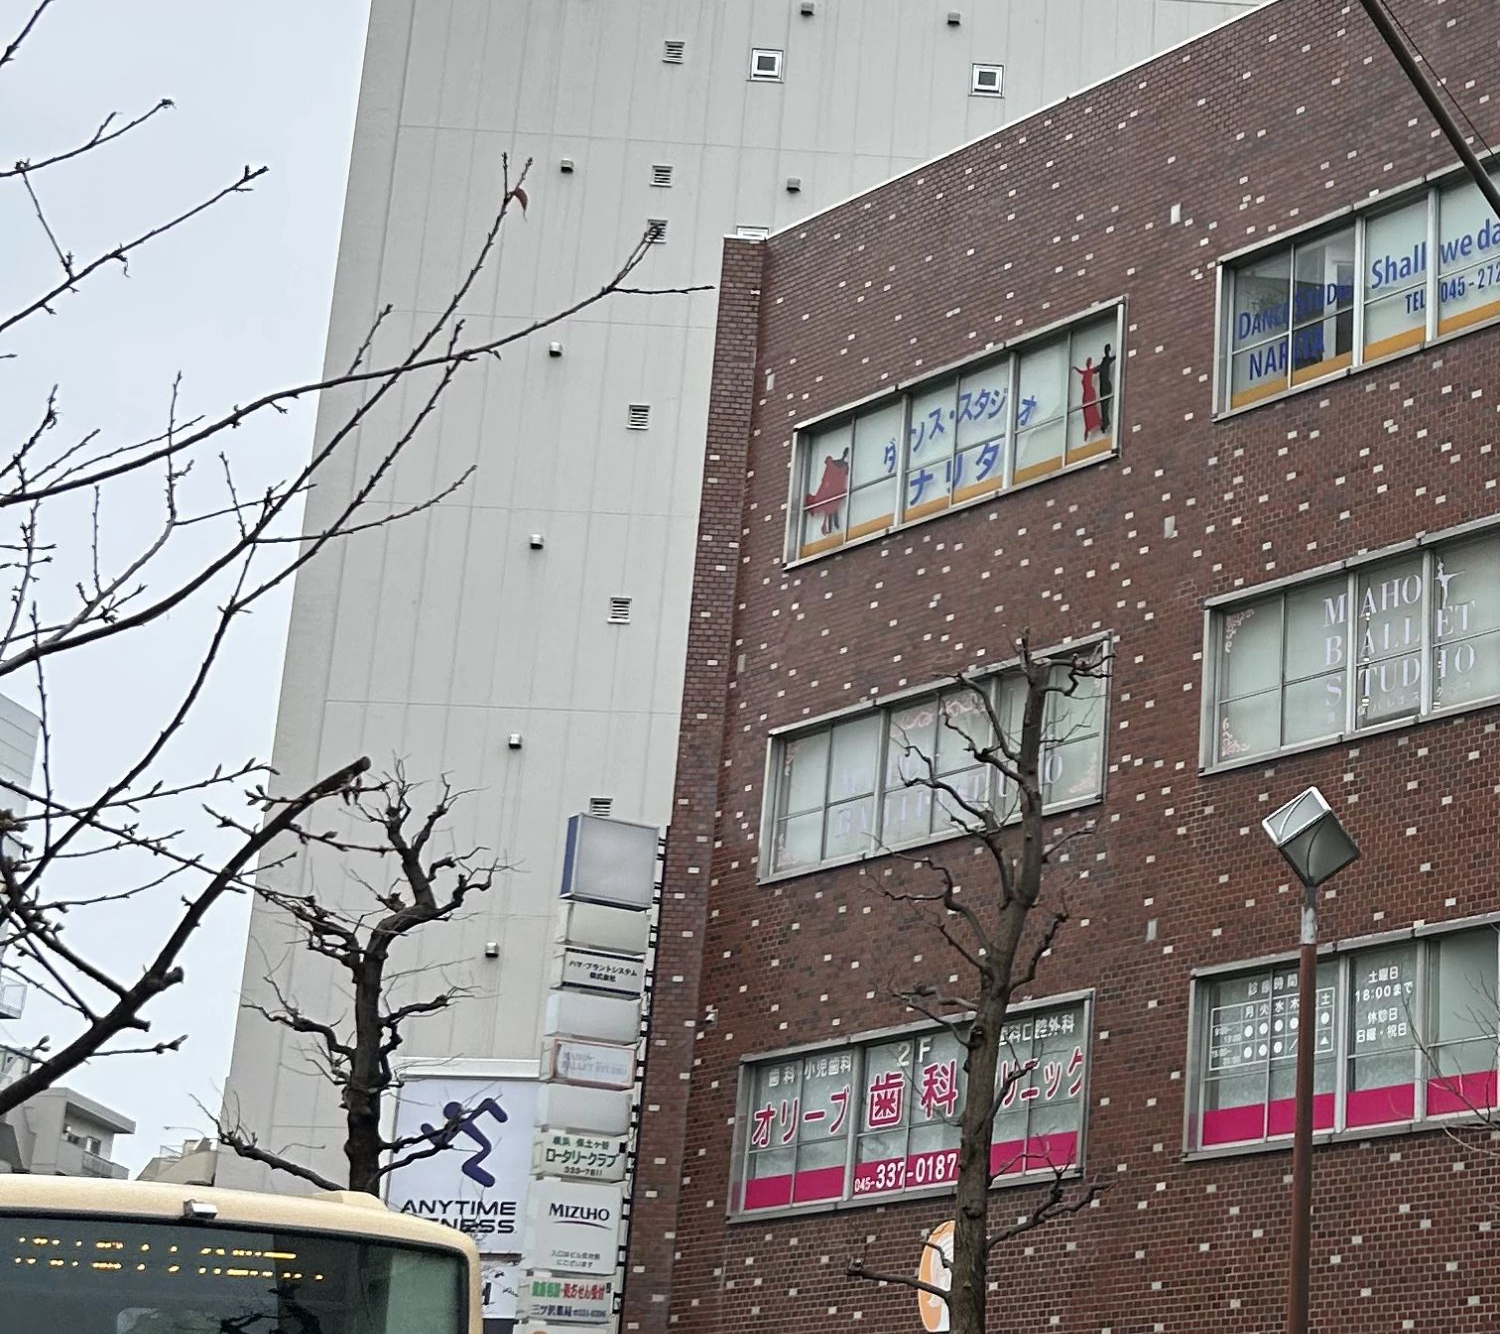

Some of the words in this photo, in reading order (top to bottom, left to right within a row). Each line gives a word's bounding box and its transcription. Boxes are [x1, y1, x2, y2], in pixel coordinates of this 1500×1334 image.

[1371, 243, 1426, 290] Shall
[1439, 235, 1473, 265] we
[1405, 289, 1426, 314] TEL
[910, 443, 1001, 505] ナリタ
[1323, 574, 1422, 627] MAHO
[1326, 601, 1475, 666] BALLET
[1326, 644, 1475, 707] STUDIO
[1368, 966, 1399, 984] 土曜日
[896, 1036, 935, 1067] 2F
[752, 1083, 850, 1148] オリーブ
[546, 1148, 619, 1167] ロータリークラブ
[855, 1152, 959, 1193] 045-337-0187
[400, 1200, 517, 1215] ANYTIME
[549, 1203, 610, 1221] MIZUHO
